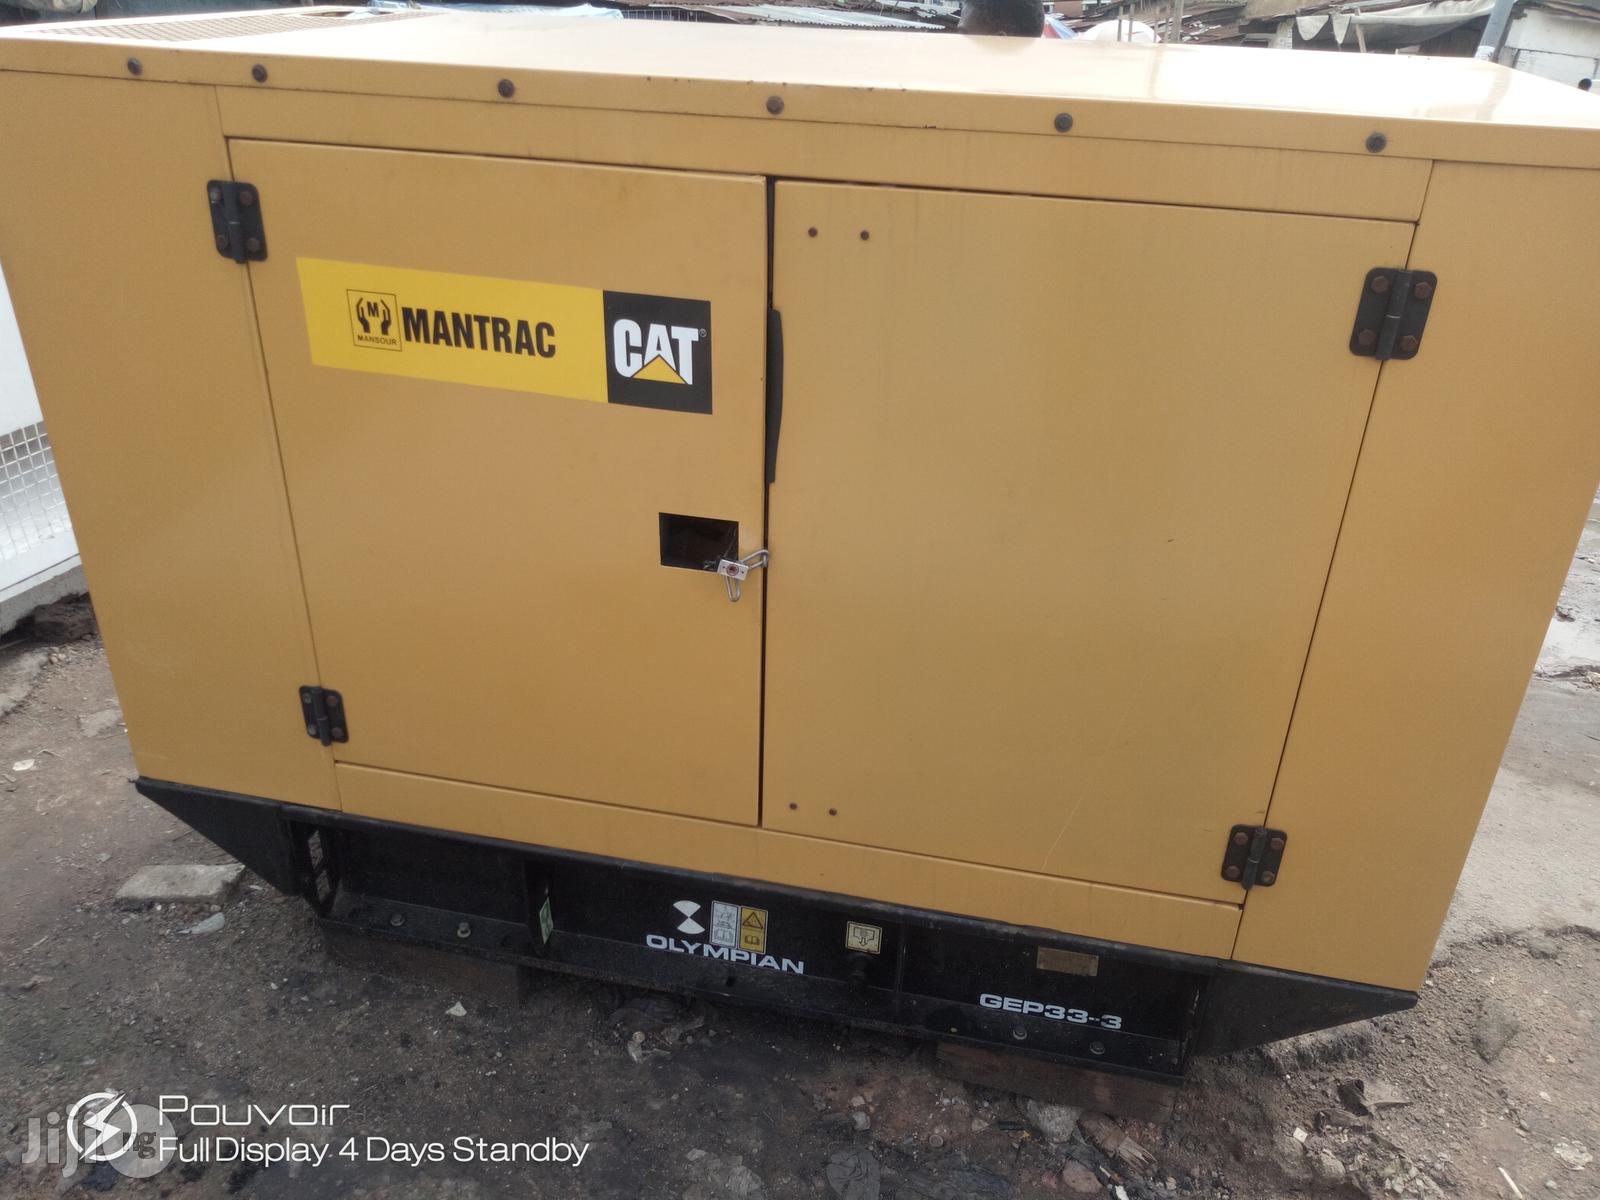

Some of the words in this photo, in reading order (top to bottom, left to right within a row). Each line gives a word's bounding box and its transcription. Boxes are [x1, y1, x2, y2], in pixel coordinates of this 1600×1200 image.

[366, 301, 380, 318] M
[357, 334, 398, 346] MANSOUR
[401, 306, 556, 358] MANTRAC
[646, 934, 805, 975] OLYMPIAN
[979, 993, 1123, 1030] GEP33-3
